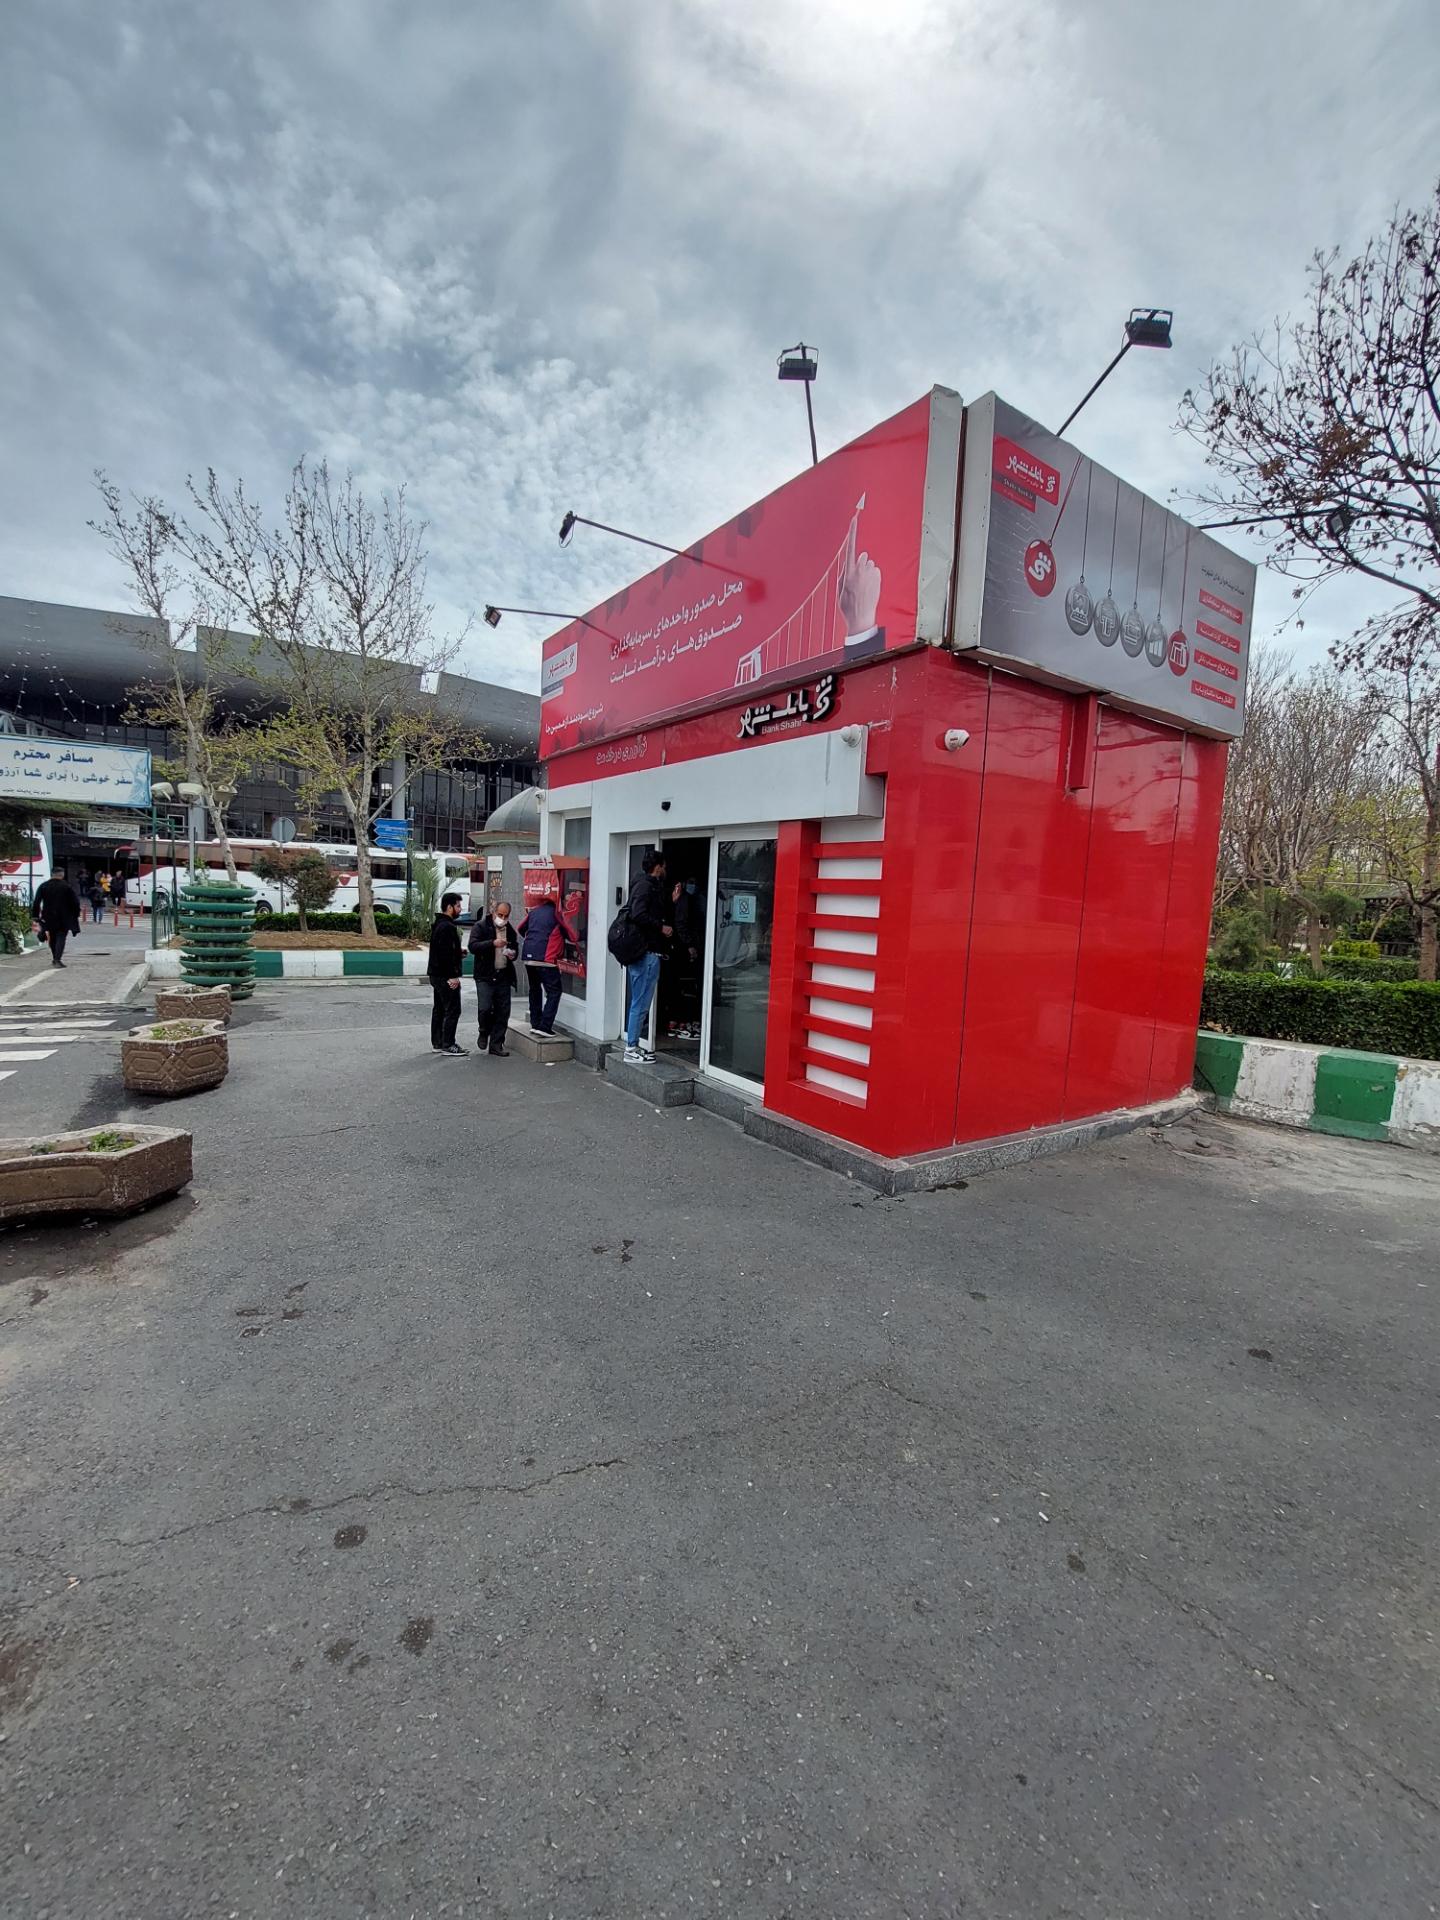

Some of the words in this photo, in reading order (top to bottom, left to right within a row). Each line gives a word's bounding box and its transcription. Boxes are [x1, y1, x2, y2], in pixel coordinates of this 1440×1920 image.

[1006, 455, 1028, 474] شهر
[718, 581, 743, 606] محل
[690, 594, 716, 622] صدور
[654, 606, 689, 639] واحدهای
[637, 645, 666, 673] درآمد
[610, 658, 637, 683] ثابت
[772, 689, 809, 722] بانک
[737, 704, 771, 738] شهر
[761, 723, 780, 735] Bank
[781, 719, 803, 731] Shahr
[14, 749, 51, 760] محترم
[57, 750, 93, 763] مسافر
[24, 767, 42, 777] شما
[46, 771, 67, 782] برای
[71, 773, 79, 782] را
[83, 774, 110, 784] خوشی
[115, 776, 133, 785] سفر
